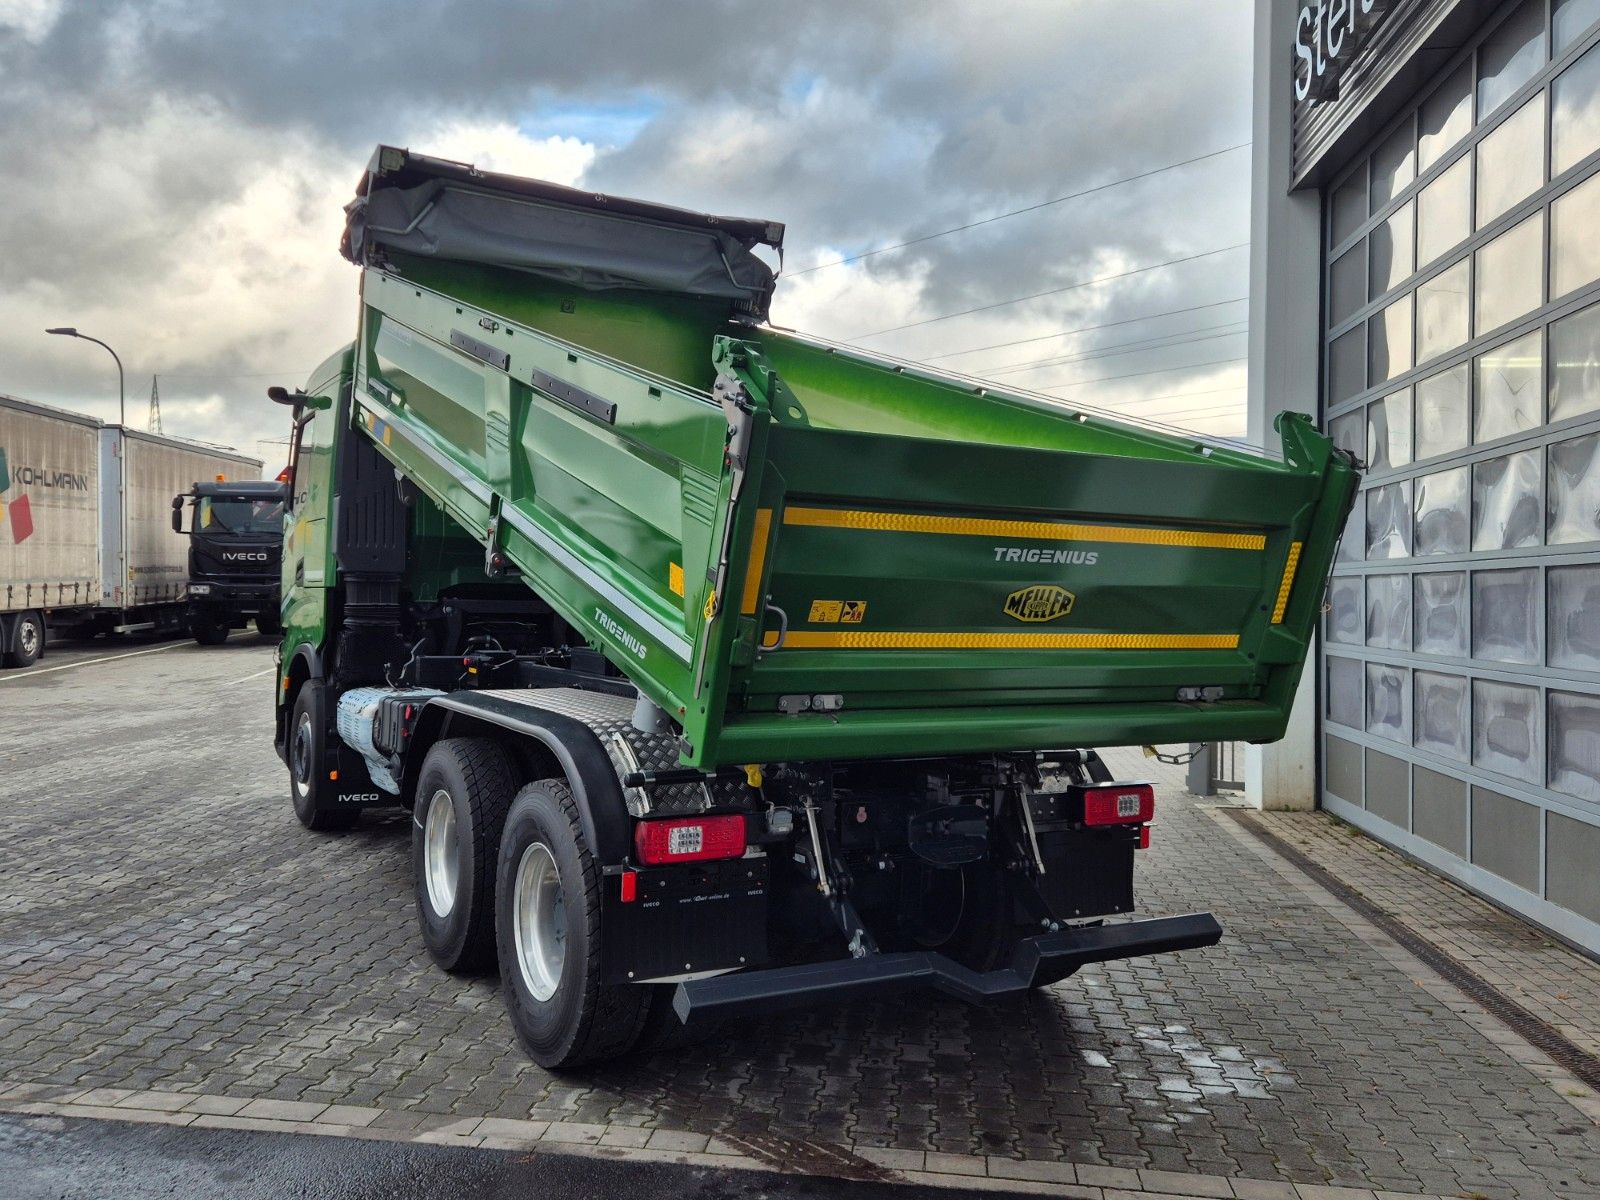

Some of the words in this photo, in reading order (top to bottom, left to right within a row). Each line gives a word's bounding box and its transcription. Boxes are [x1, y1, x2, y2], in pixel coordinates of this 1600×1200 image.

[1295, 0, 1375, 101] Ste
[12, 465, 88, 491] KOHLMANN
[222, 552, 267, 560] IVECO
[994, 547, 1099, 565] TRIGENIUS
[1007, 588, 1072, 619] MEILLER
[595, 607, 647, 659] TRIGENIUS
[338, 793, 379, 802] IVECO
[747, 889, 763, 897] IVECO
